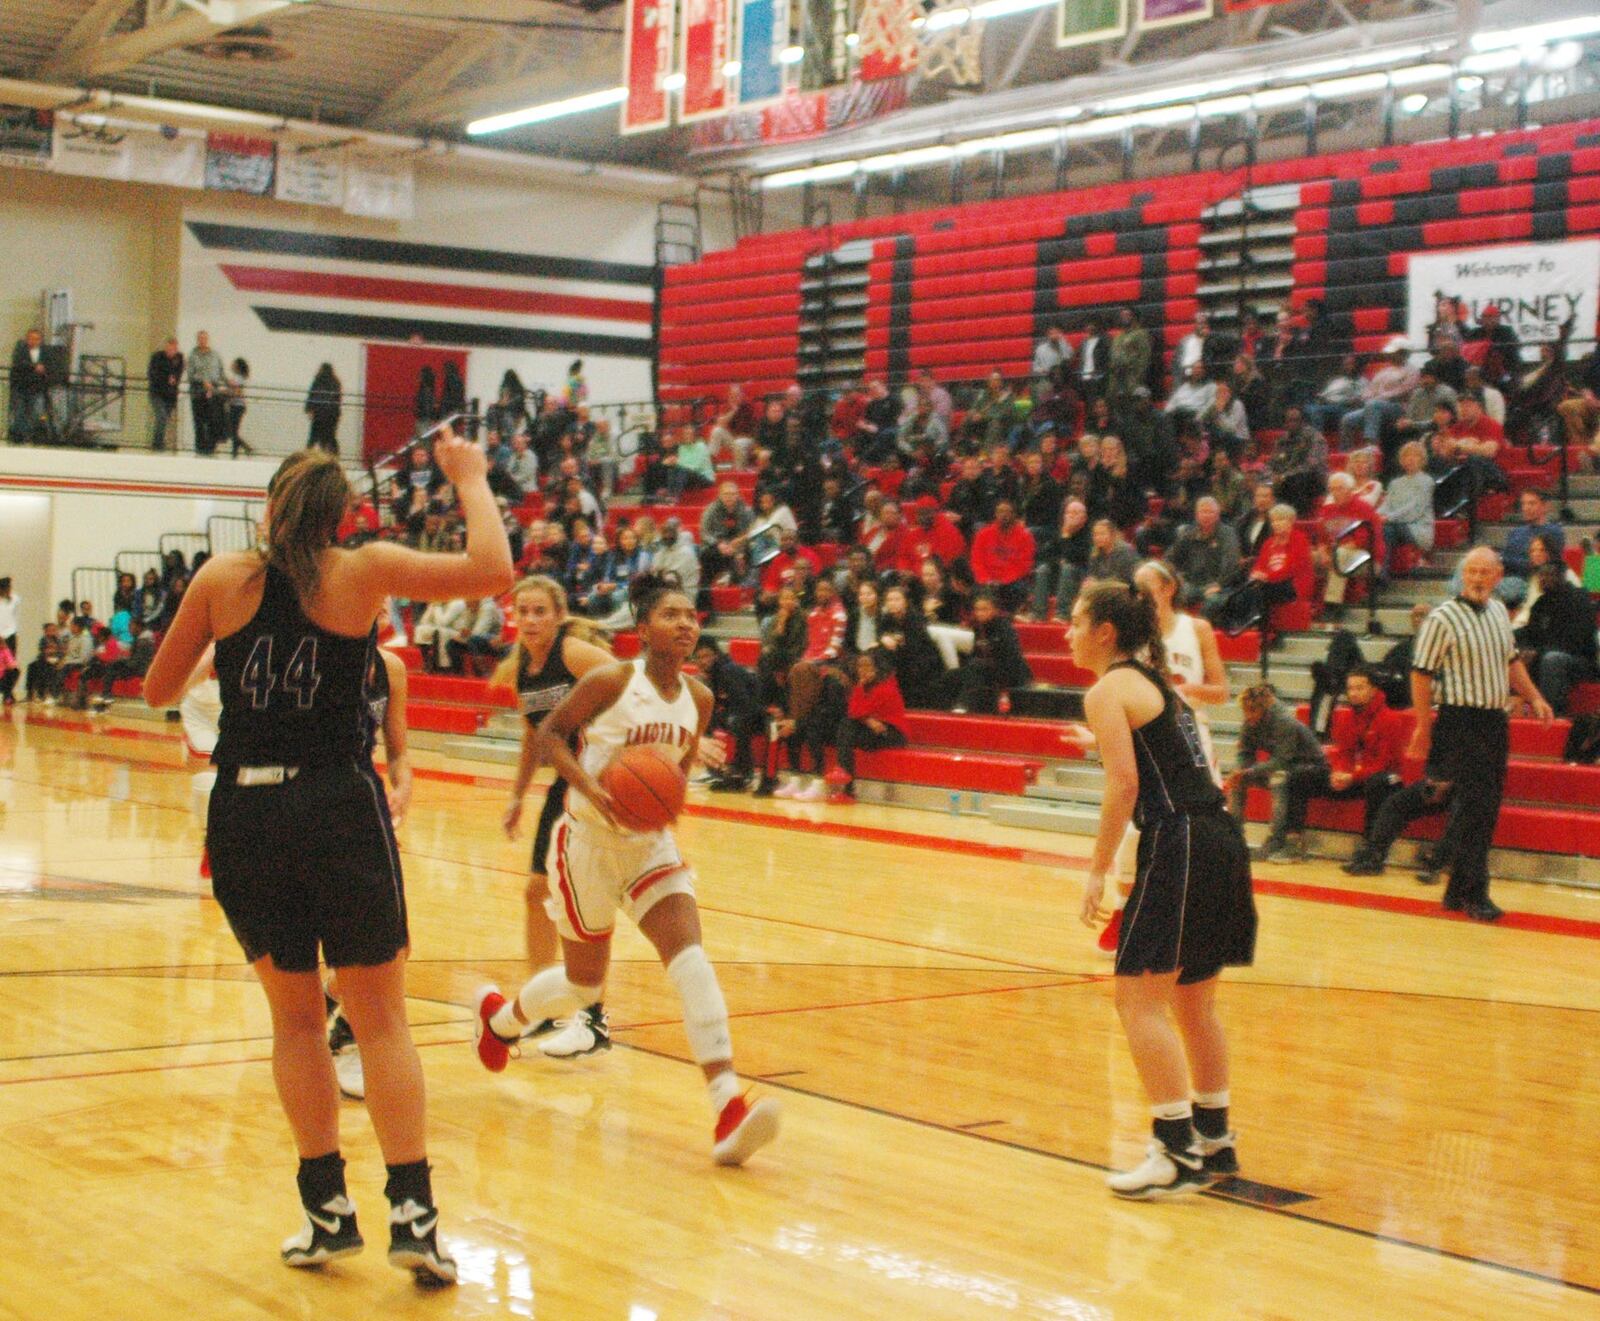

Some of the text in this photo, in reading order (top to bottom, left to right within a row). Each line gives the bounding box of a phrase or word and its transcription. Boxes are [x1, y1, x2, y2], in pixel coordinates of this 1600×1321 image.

[1456, 258, 1556, 279] Welcome to
[1472, 290, 1584, 326] URNEY
[240, 636, 322, 710] 44
